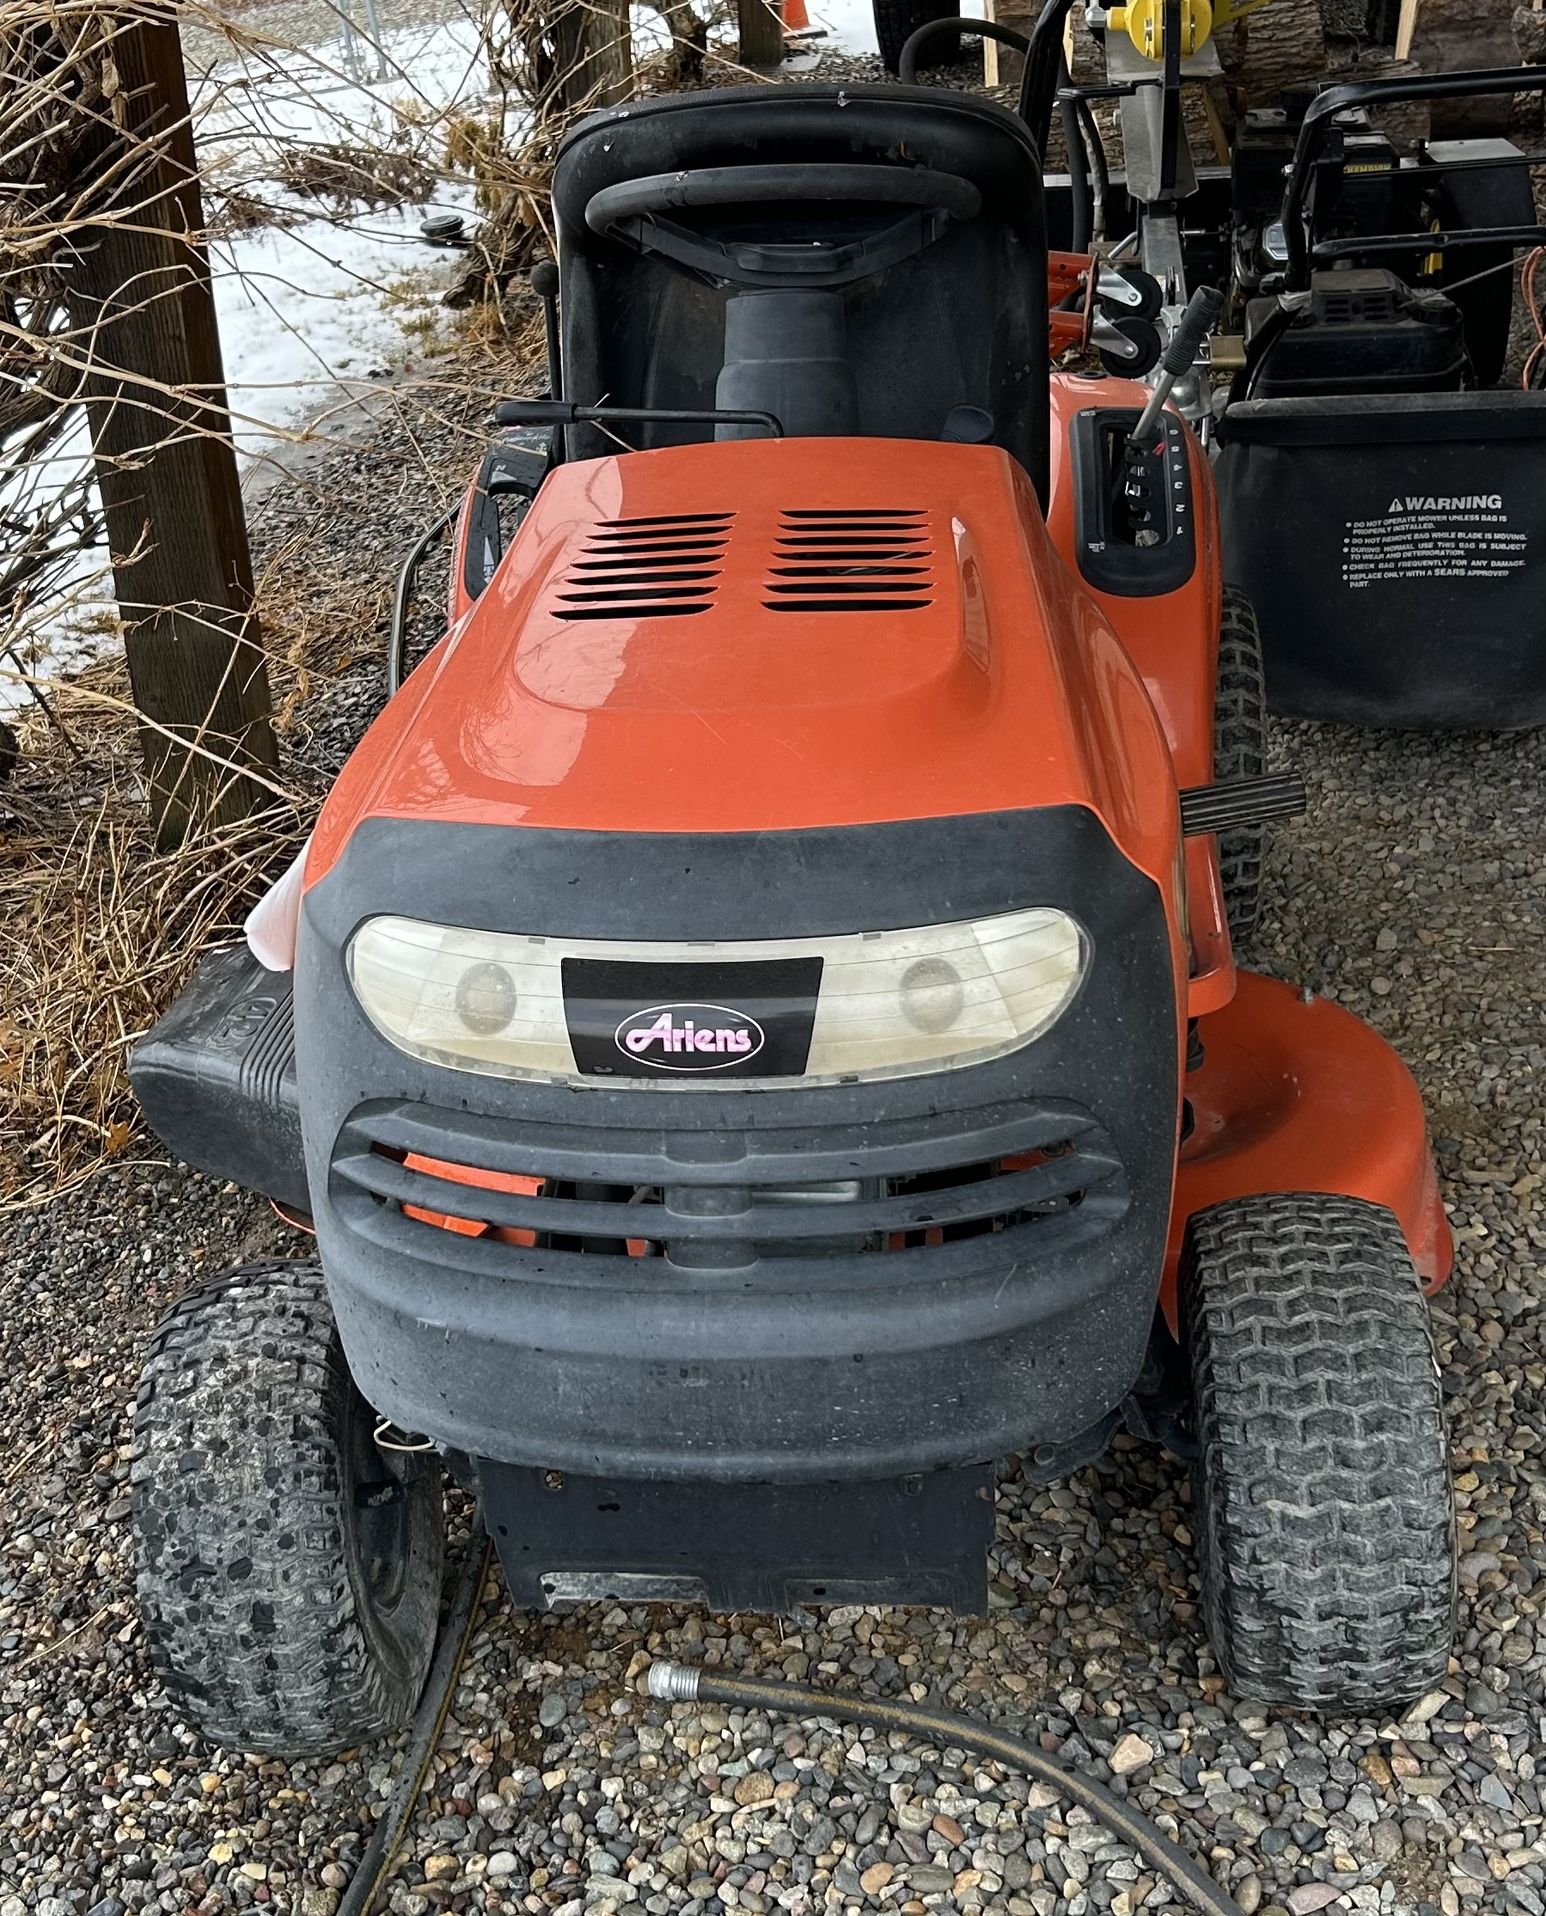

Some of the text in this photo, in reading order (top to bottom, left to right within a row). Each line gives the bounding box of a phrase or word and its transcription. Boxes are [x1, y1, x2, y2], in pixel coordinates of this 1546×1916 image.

[1174, 481, 1184, 489] 3
[1405, 494, 1502, 510] WARNING
[1175, 504, 1185, 512] 2
[1366, 519, 1382, 527] NOT
[1383, 516, 1416, 525] OPERATE
[1176, 526, 1183, 535] 1
[1352, 523, 1435, 535] PROPERLY INSTALLED.
[1381, 534, 1412, 543] REMOVE
[1413, 532, 1430, 540] BAG
[1493, 533, 1527, 541] MOVING.
[1383, 543, 1415, 552] NORMAL
[1490, 542, 1527, 550] SUBJECT
[1402, 549, 1466, 558] DETERIORATION.
[1398, 559, 1448, 568] FREQUENTLY
[1349, 572, 1382, 580] REPLACE
[1434, 568, 1466, 576] SEARS
[1467, 569, 1509, 577] APPROVED
[625, 1013, 751, 1053] Ariens
